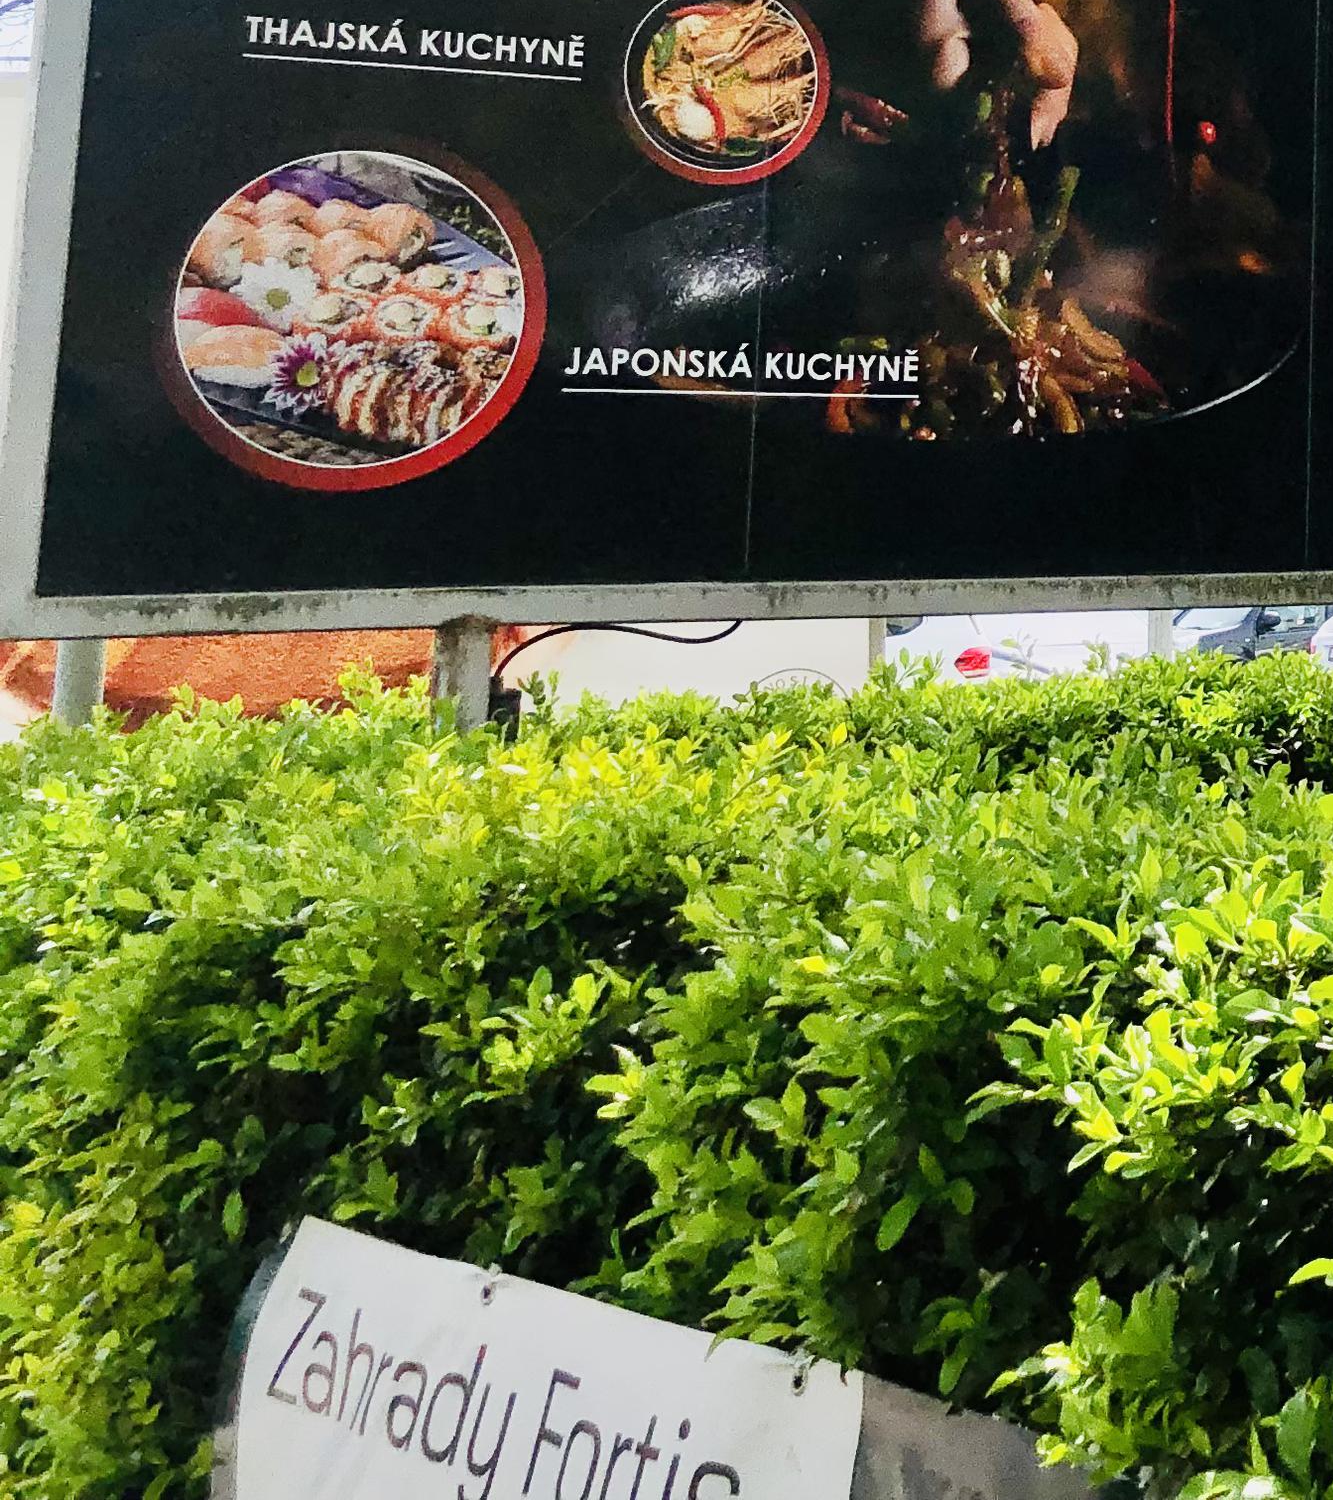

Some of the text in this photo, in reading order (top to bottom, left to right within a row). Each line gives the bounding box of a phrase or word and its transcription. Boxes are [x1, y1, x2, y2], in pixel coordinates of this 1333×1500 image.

[245, 15, 585, 68] THAJSKÁ KUCHYNĚ
[564, 342, 919, 383] JAPONSKÁ KUCHYNĚ
[266, 1287, 518, 1500] Zahrady
